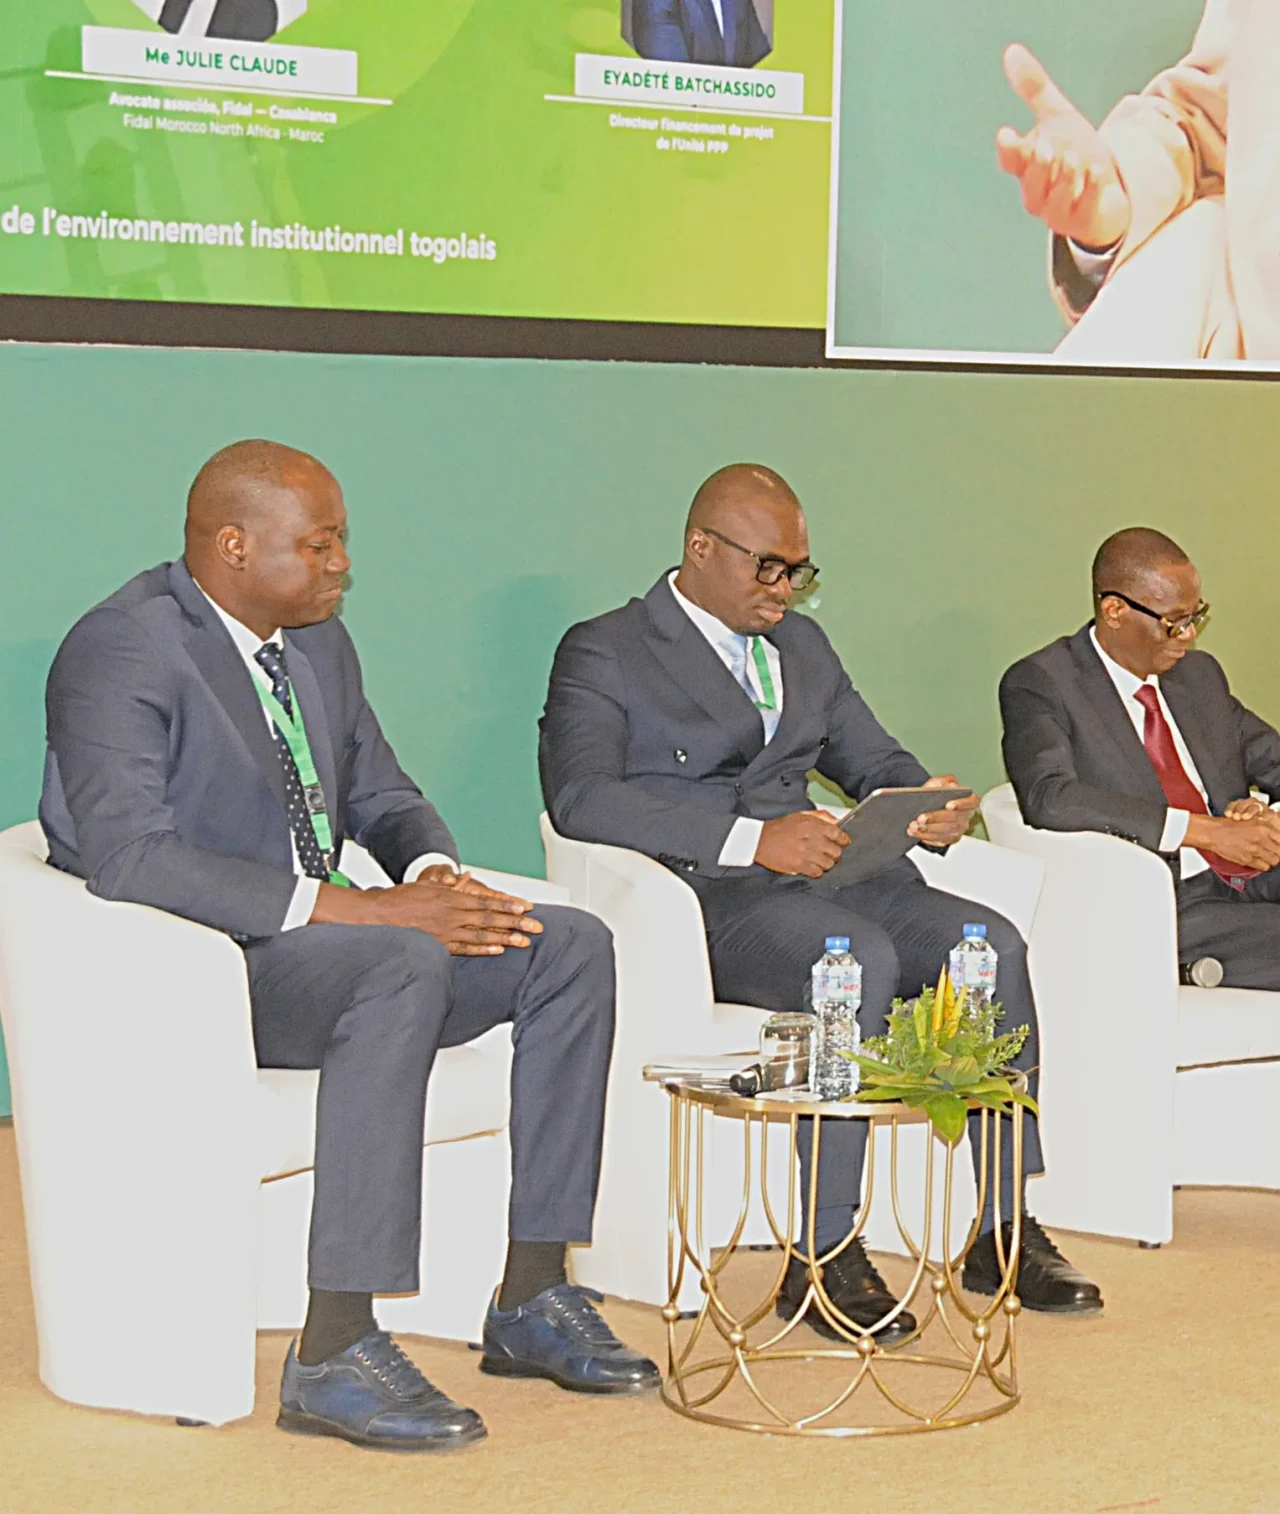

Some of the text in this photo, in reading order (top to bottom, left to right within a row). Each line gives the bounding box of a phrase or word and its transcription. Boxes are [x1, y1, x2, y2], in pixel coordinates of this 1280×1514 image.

[145, 47, 298, 76] Me JULIE CLAUDE
[603, 69, 776, 98] EYADÉTÉ BATCHASSIDO
[109, 92, 160, 110] Avocate
[222, 99, 252, 116] Fidal
[269, 104, 337, 124] Casablanca
[123, 113, 153, 129] Fidal
[155, 117, 207, 135] Morocco
[209, 121, 244, 136] North
[246, 124, 280, 140] Africa
[288, 127, 324, 143] Maroc
[609, 112, 658, 131] Directeur
[661, 116, 726, 135] financement
[743, 125, 774, 141] projet
[656, 136, 670, 150] de
[707, 140, 729, 154] PPP
[1, 204, 497, 264] de l'environnement institutionnel togolais
